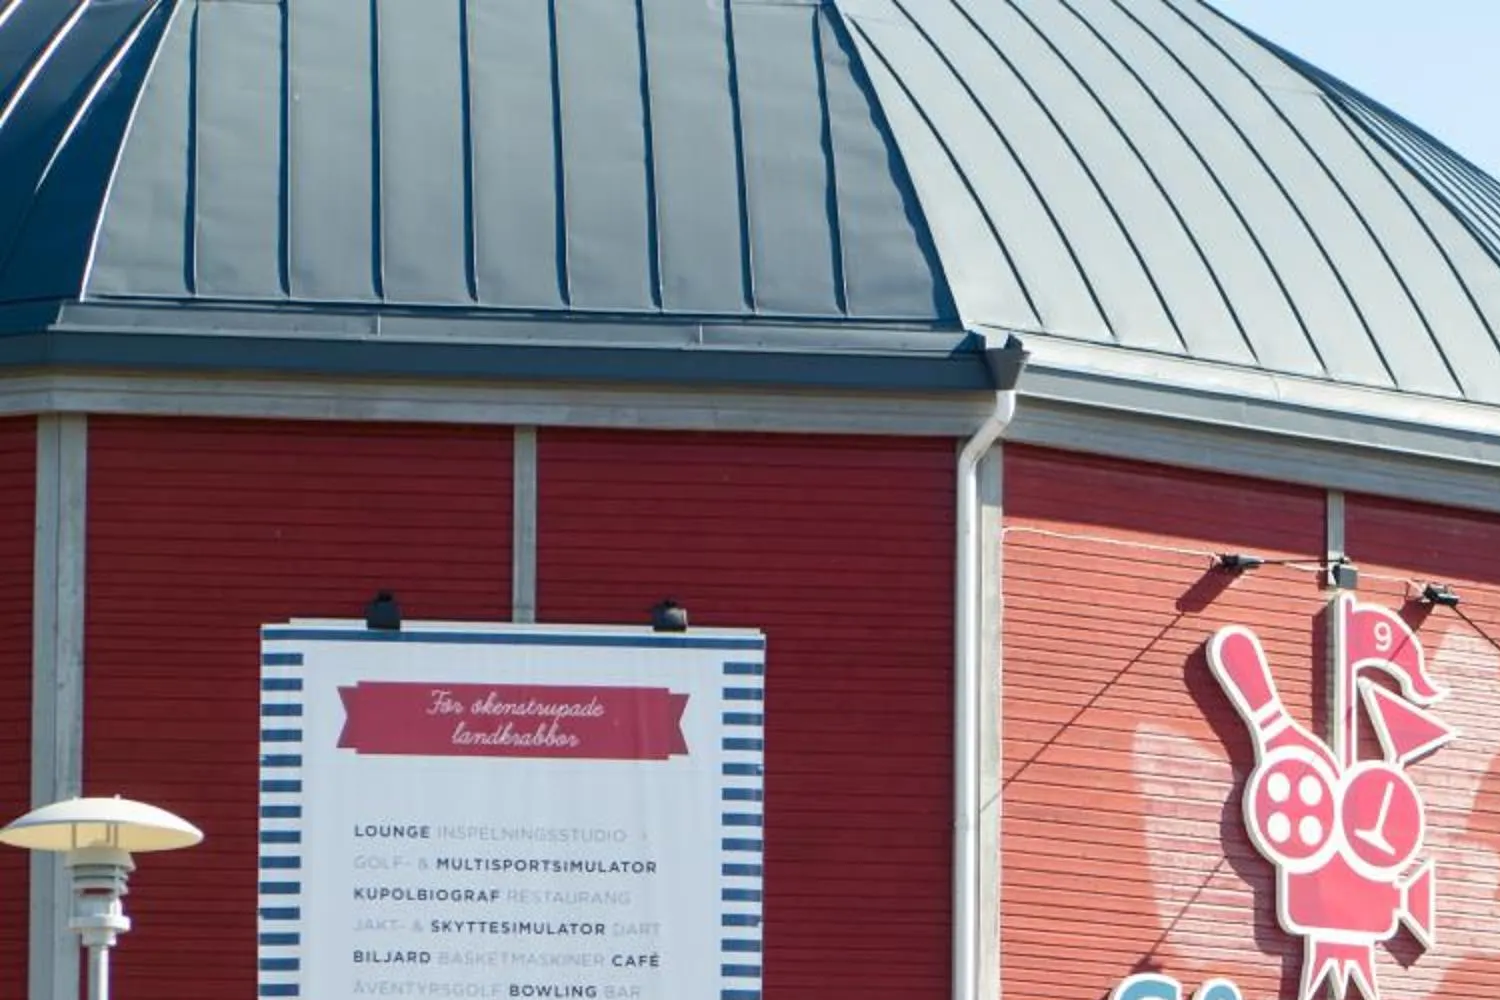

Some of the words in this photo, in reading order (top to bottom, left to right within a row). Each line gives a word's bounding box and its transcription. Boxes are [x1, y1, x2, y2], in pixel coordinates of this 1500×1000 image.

[1373, 621, 1393, 652] 9
[353, 825, 431, 839] LOUNGE
[437, 826, 628, 843] INSPELNINGSSTUDIO
[436, 857, 657, 874] MULTISPORTSIMULATOR
[353, 887, 500, 902] KUPOLBIOGRAF
[506, 889, 632, 905] RESTAURANG
[431, 920, 606, 936] SKYTTESIMULATOR
[612, 922, 661, 937] DART
[353, 950, 431, 964] BILJARD
[437, 951, 605, 968] BASKETMASKINER
[611, 951, 661, 967] CAFÉ
[509, 984, 597, 999] BOWLING
[604, 985, 641, 999] BAR
